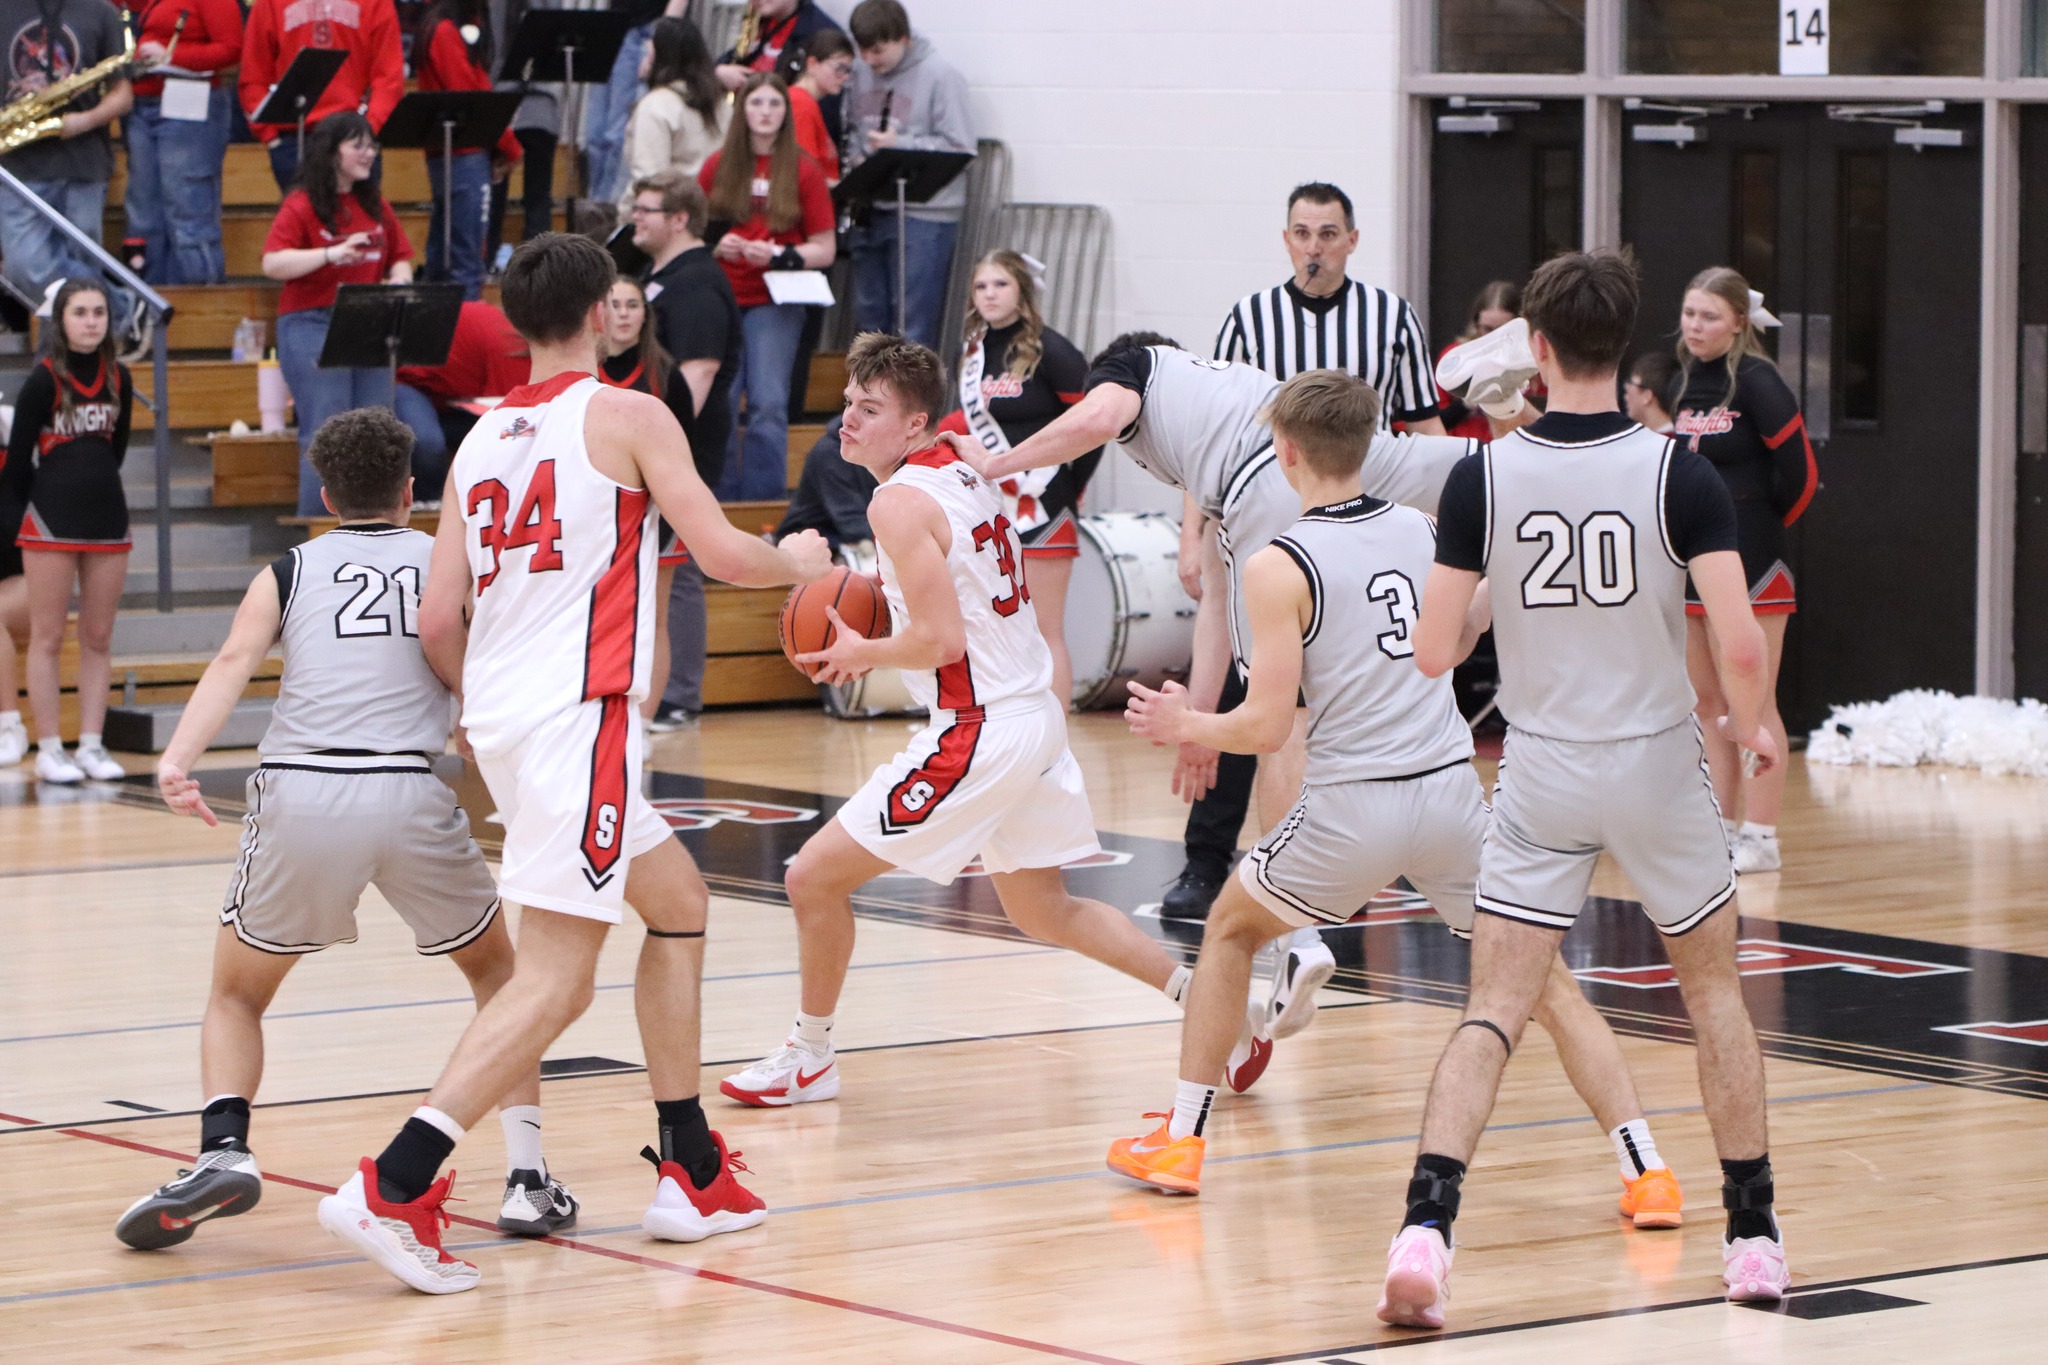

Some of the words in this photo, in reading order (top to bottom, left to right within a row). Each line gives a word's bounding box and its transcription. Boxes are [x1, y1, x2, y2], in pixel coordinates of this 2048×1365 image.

[1786, 8, 1826, 46] 14
[965, 358, 1006, 456] SENIO
[467, 457, 564, 598] 34
[1324, 503, 1346, 513] NIKE
[1346, 498, 1363, 509] PRO
[1517, 511, 1638, 609] 20
[333, 561, 421, 639] 21
[1366, 569, 1419, 660] 3
[595, 802, 619, 850] S
[901, 779, 936, 812] S
